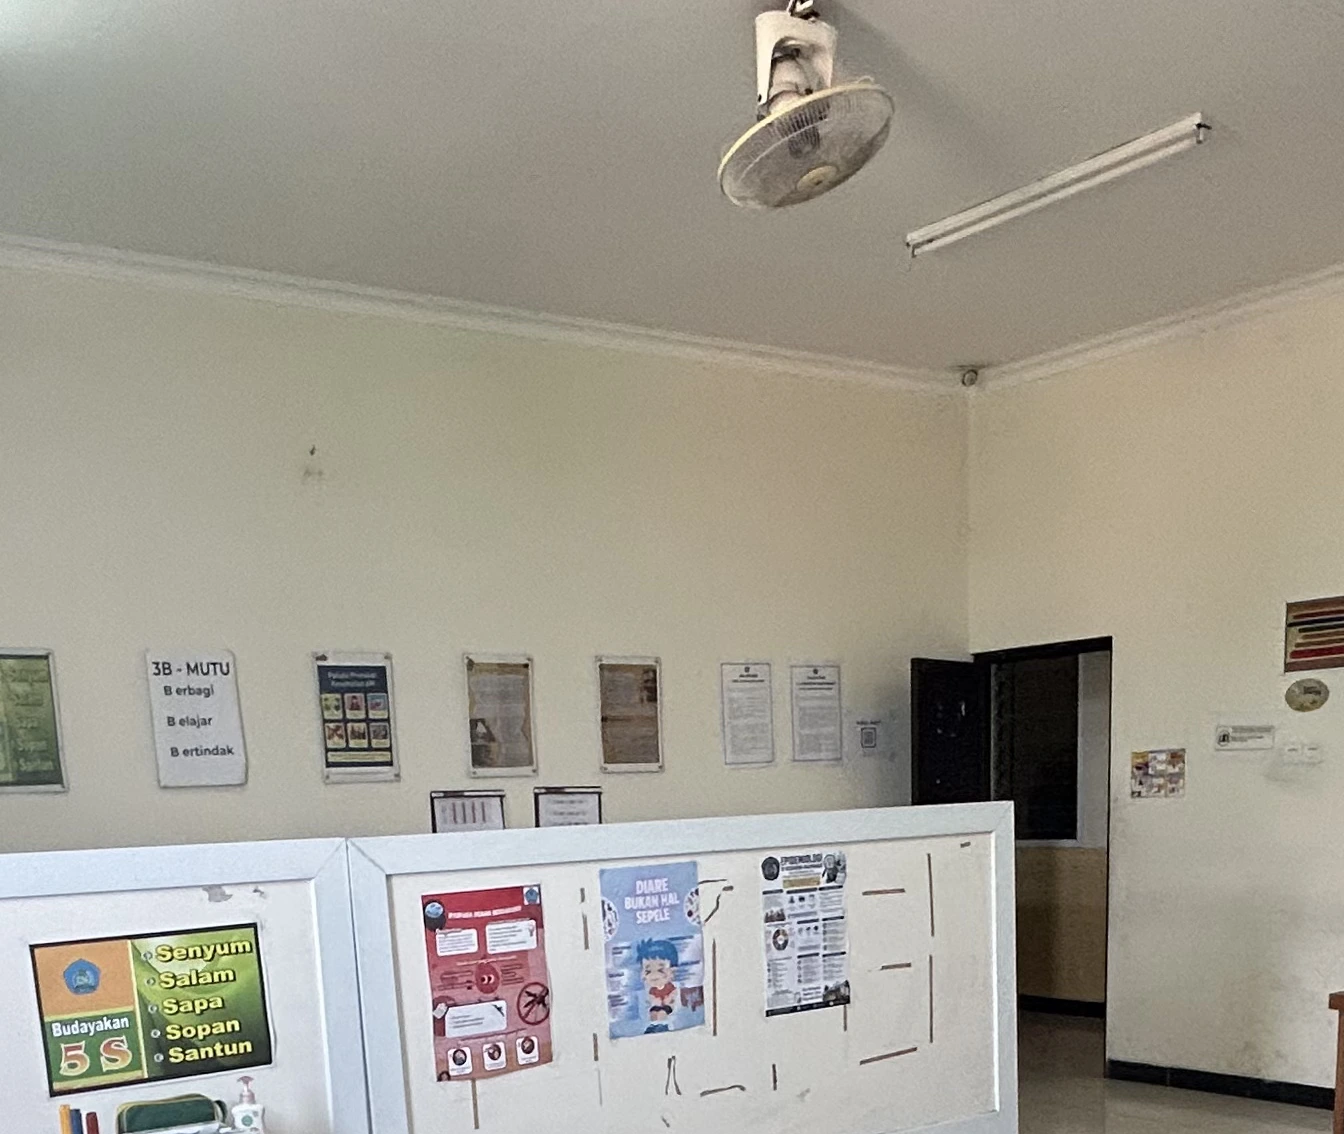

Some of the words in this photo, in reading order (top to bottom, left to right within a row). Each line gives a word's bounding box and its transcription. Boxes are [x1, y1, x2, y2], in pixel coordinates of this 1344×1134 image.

[151, 661, 173, 676] 3B
[186, 661, 230, 676] MUTU
[635, 877, 669, 895] DIARE
[624, 895, 659, 910] BUKAN
[660, 892, 680, 906] HAL
[635, 907, 670, 925] SEPELE
[155, 939, 253, 963] Senyum
[158, 968, 236, 990] Salam
[162, 995, 224, 1016] Sapa
[51, 1015, 130, 1038] Budayakan
[165, 1017, 241, 1042] Sopan
[168, 1039, 253, 1064] Santun
